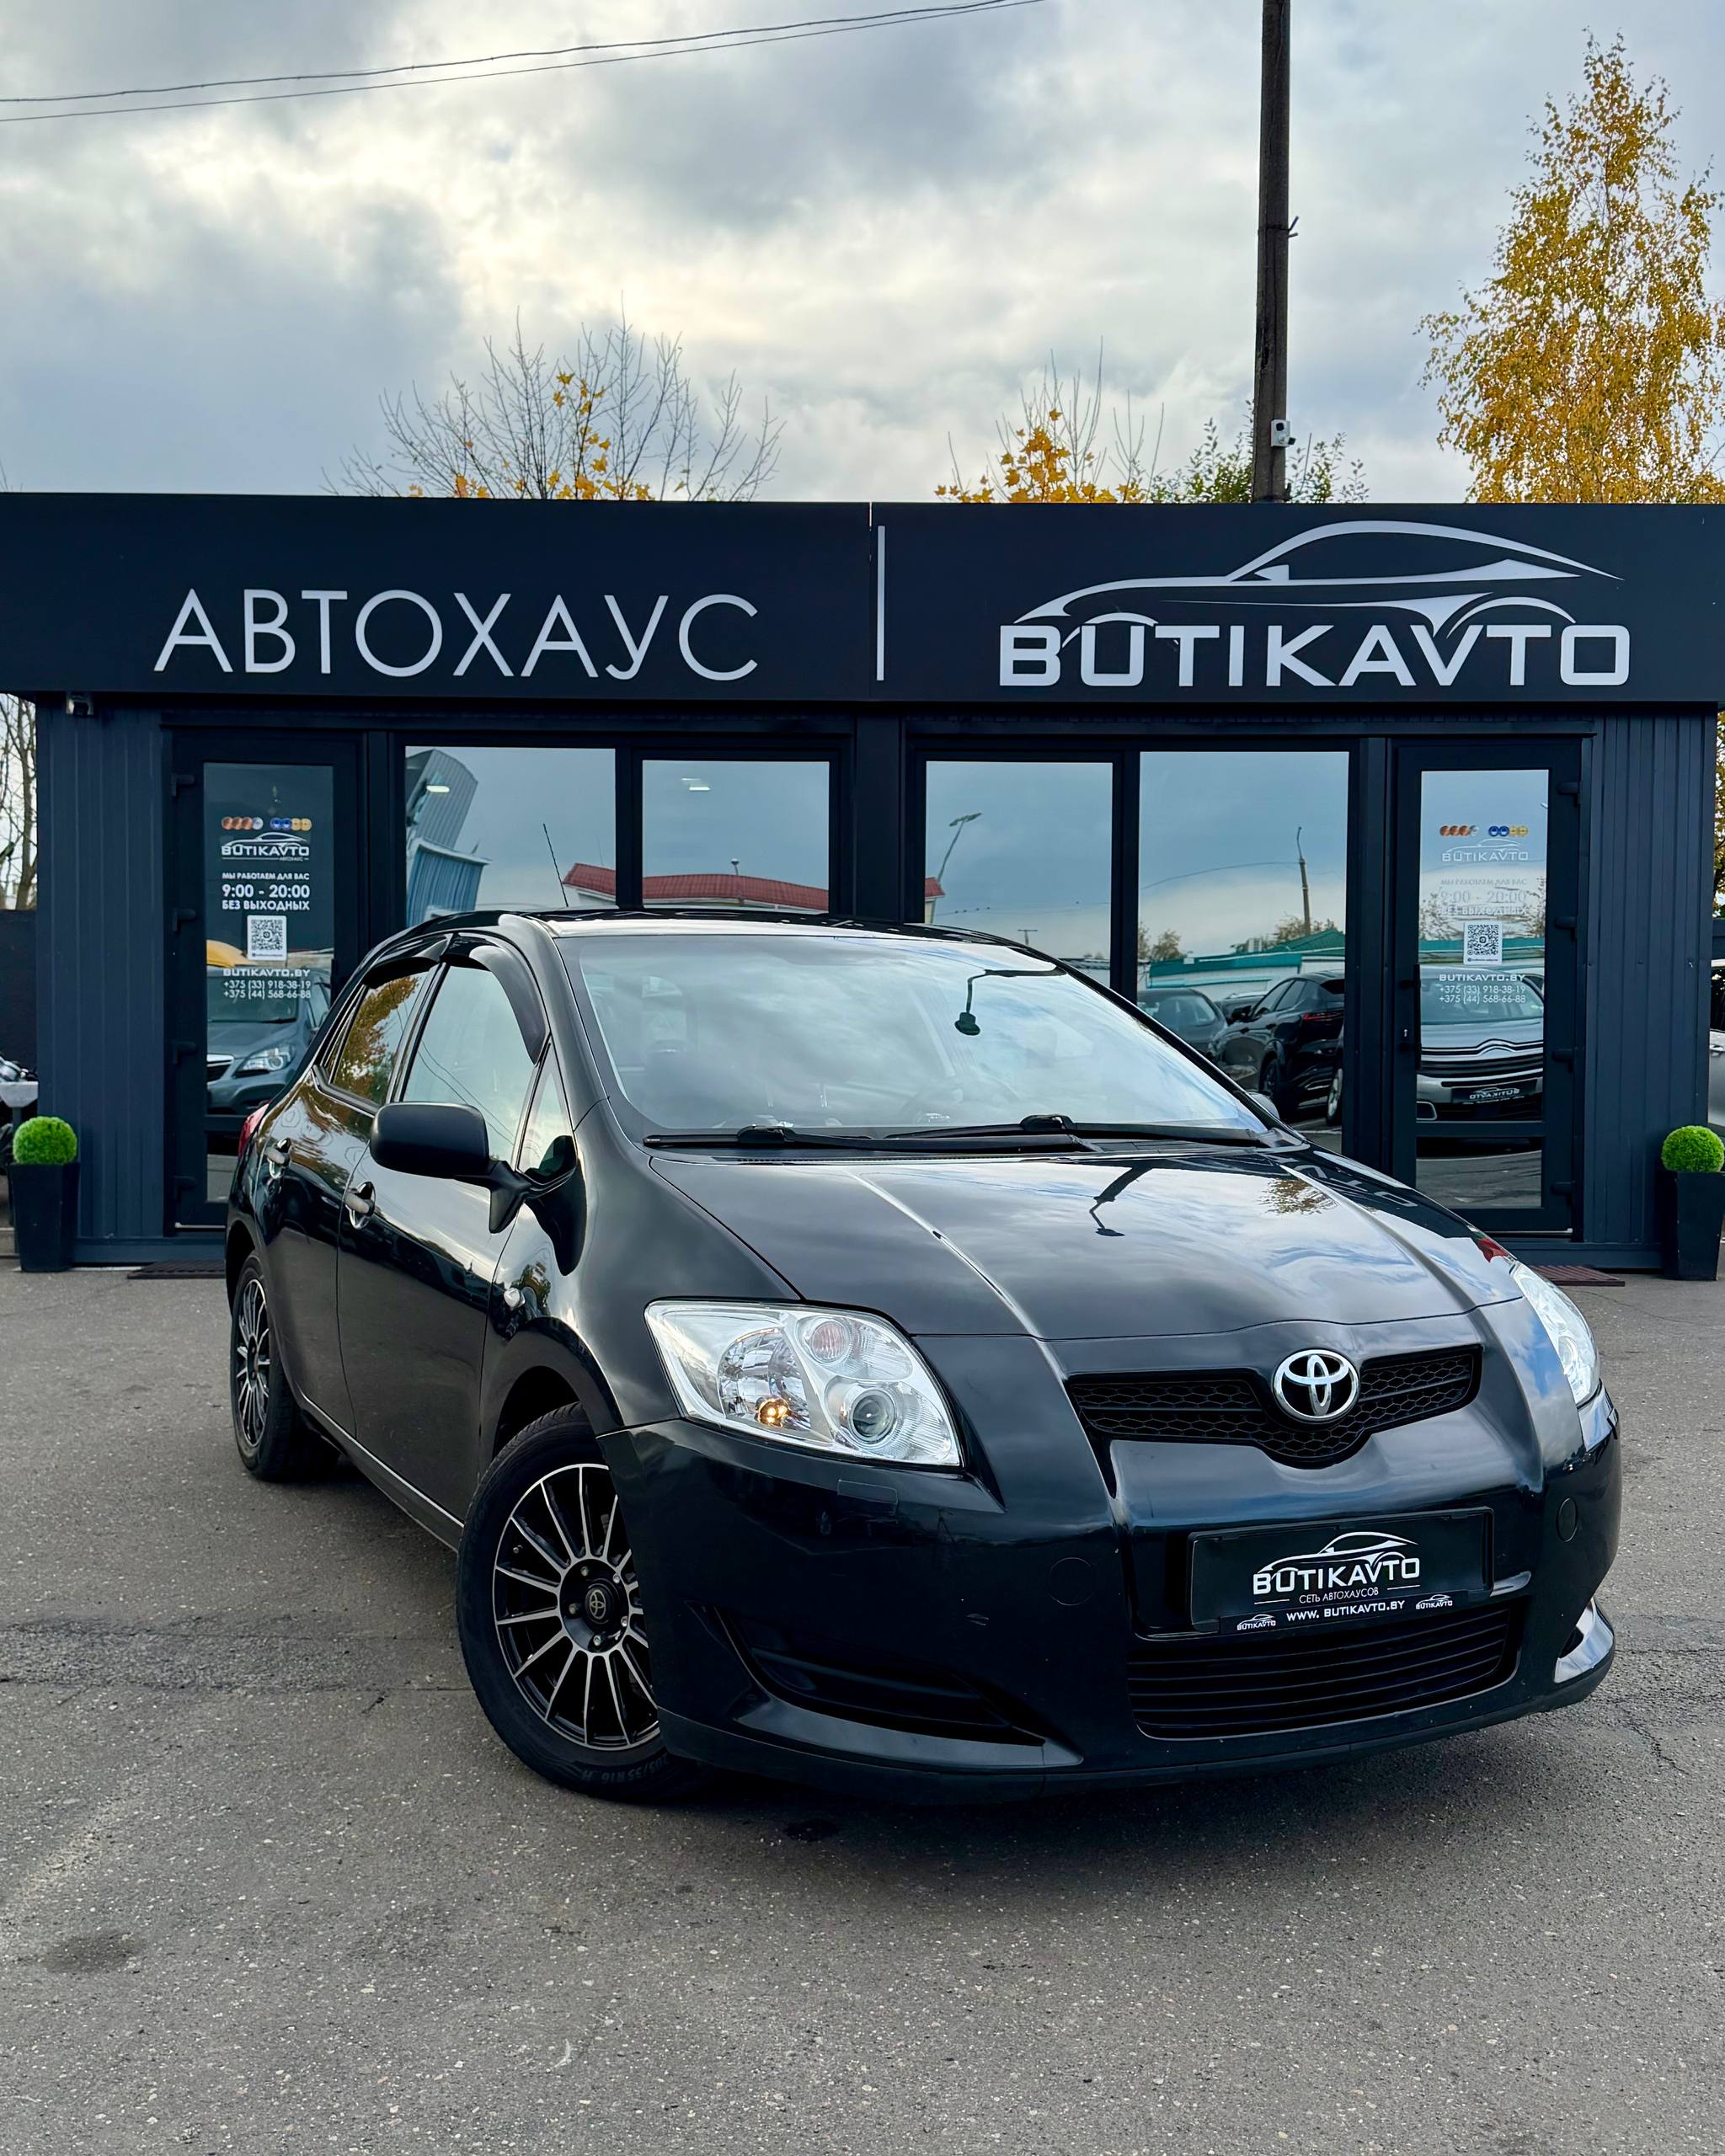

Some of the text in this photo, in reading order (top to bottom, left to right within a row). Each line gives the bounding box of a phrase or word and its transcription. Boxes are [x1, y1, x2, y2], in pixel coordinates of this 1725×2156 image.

[154, 589, 759, 681] АВТОХАУС
[1000, 624, 1631, 686] BUTIKAVTO
[222, 846, 310, 856] BUTIKAVTO
[1442, 851, 1529, 862] BUTIKAVTO
[276, 873, 292, 881] ДЛЯ
[294, 873, 310, 881] ВАС
[222, 884, 254, 898] 9:00
[269, 885, 310, 898] 20:00
[1441, 890, 1470, 903] 9:00
[1487, 890, 1526, 903] 20:00
[222, 900, 310, 910] БЕЗ ВЫХОДНЫХ
[224, 979, 311, 990] +375 (33) 918-38-19
[1439, 985, 1526, 995] +375 (33) 918-38-19
[224, 989, 311, 1000] +375 (44) 568-66-88
[1439, 994, 1526, 1005] +375 (44) 568-66-88
[1253, 1557, 1420, 1595] BUTIKAVTO
[1299, 1587, 1379, 1604] СЕТЬ АВТОХАУСОВ
[1324, 1601, 1406, 1618] BUTIKAVTO.BY
[1415, 1599, 1453, 1609] BUTIKAVTO
[1236, 1620, 1277, 1630] BUTIKAVTO
